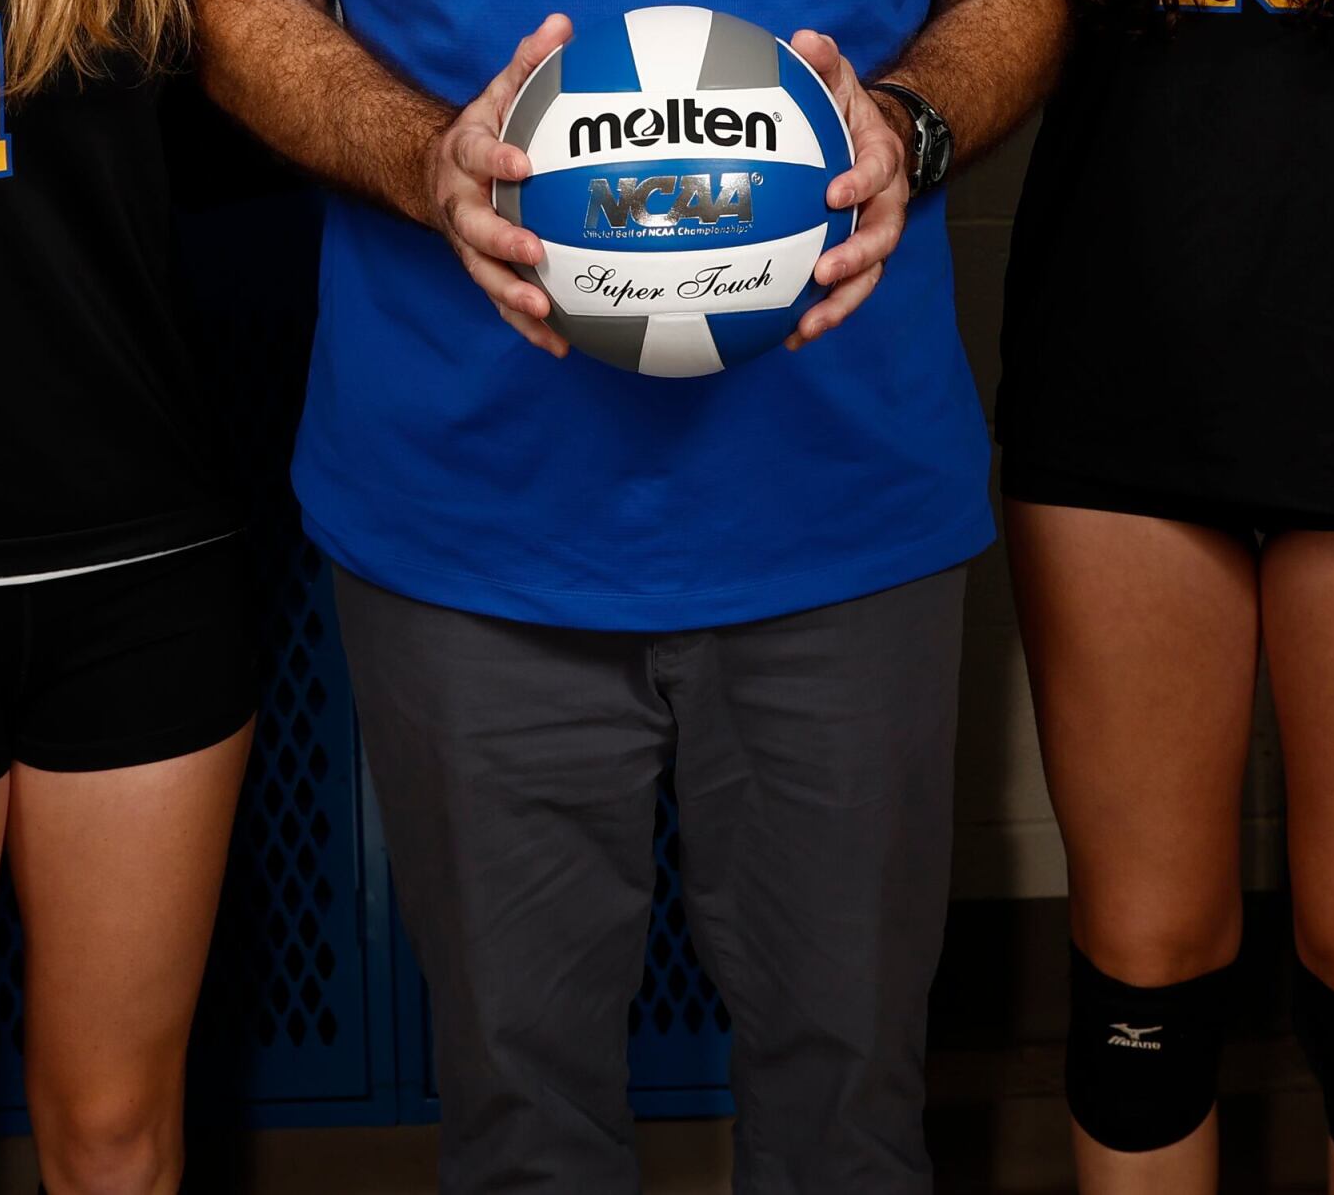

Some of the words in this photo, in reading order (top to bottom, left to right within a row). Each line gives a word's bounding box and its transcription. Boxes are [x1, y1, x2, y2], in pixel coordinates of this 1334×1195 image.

[569, 98, 777, 158] molten
[584, 172, 755, 229] NCAA
[615, 230, 635, 239] Ball
[637, 229, 647, 238] of
[648, 228, 675, 237] NCAA
[574, 264, 665, 307] Super
[676, 258, 773, 300] Touch
